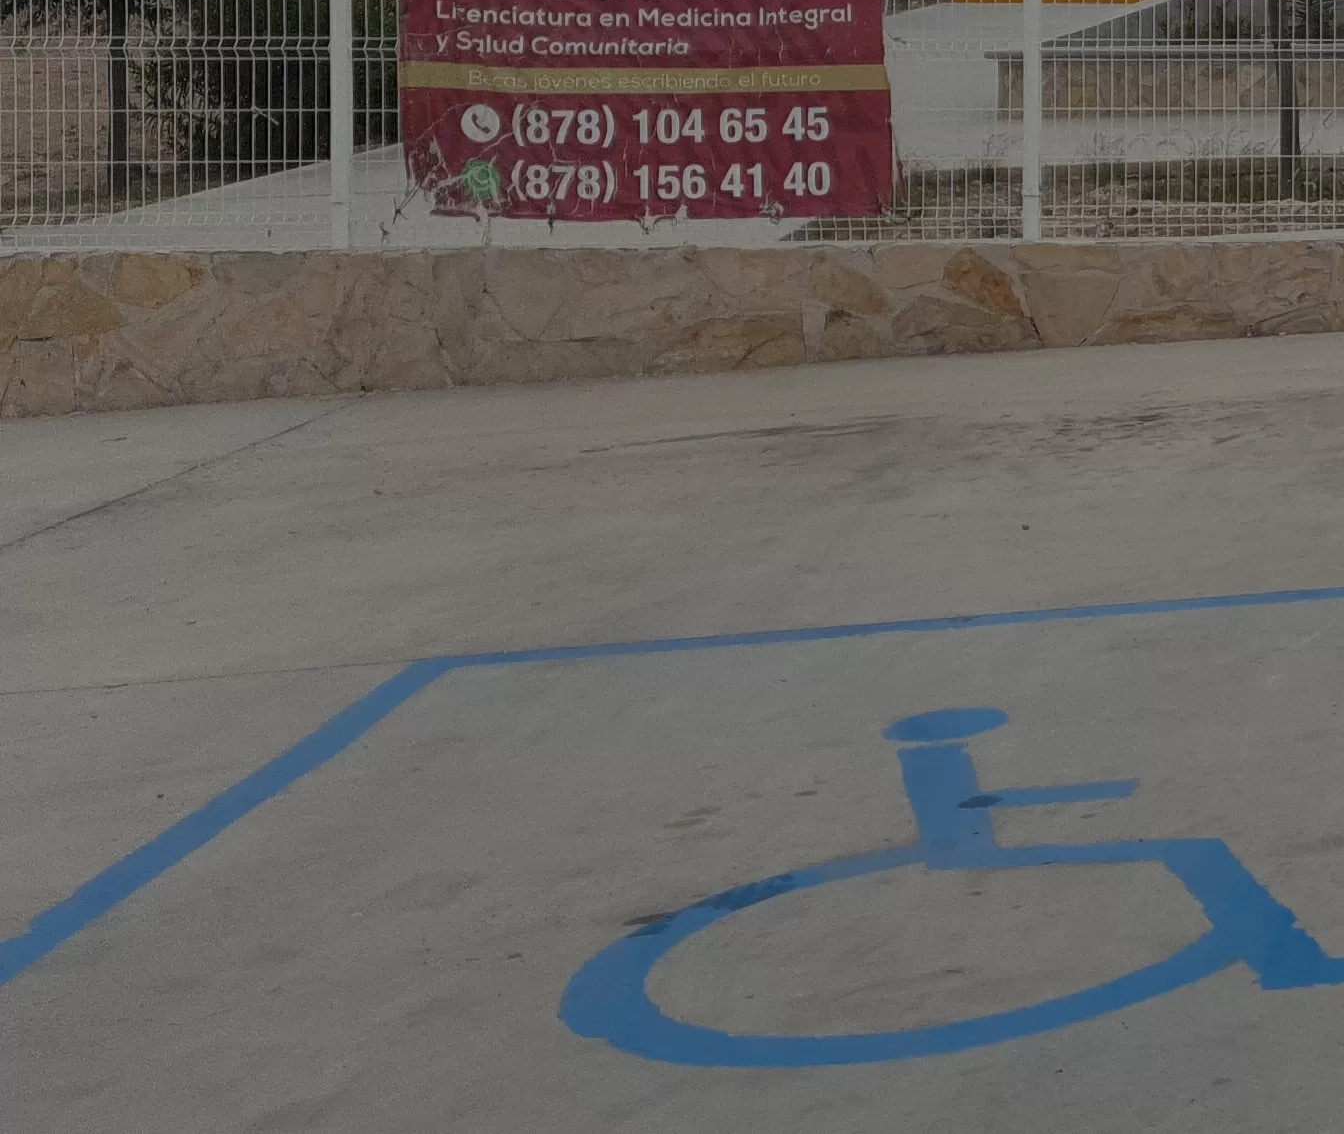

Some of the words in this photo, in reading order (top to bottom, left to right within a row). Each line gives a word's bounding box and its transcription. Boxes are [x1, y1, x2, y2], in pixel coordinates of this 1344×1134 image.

[599, 12, 629, 28] en
[639, 8, 751, 26] Medicina
[759, 4, 852, 29] Integral
[436, 35, 448, 54] y
[531, 37, 689, 56] Comunitaria
[618, 73, 731, 88] escribiendo
[739, 71, 754, 86] el
[761, 70, 821, 87] futuro
[513, 104, 615, 146] (878)
[633, 109, 704, 142] 104
[720, 108, 767, 142] 65
[782, 107, 829, 141] 45
[512, 160, 615, 202] (878)
[633, 165, 705, 199] 156
[721, 164, 763, 198] 41
[784, 162, 830, 196] 40
